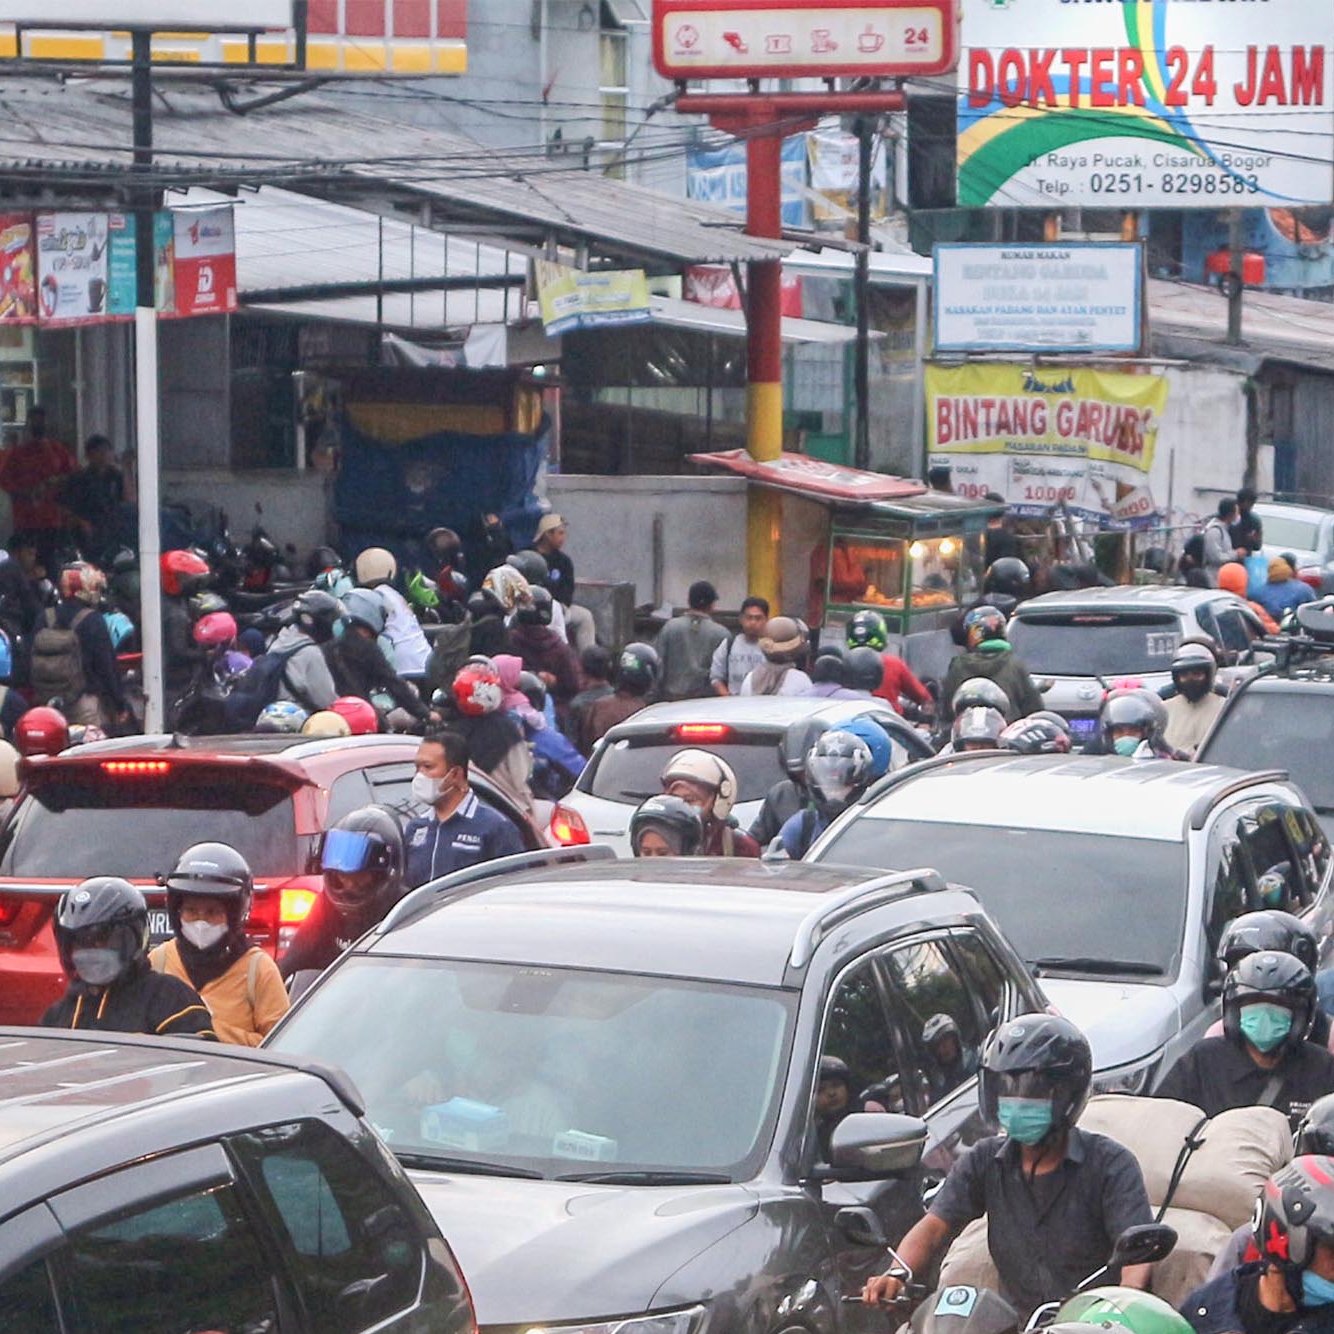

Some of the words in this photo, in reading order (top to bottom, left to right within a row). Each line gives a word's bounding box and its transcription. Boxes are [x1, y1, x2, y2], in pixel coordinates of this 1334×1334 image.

[904, 27, 929, 44] 24
[968, 47, 1145, 108] DOKTER
[1164, 46, 1216, 106] 24
[1234, 45, 1324, 106] JAM
[1047, 153, 1087, 169] Raya
[1153, 152, 1216, 168] Cisarua
[1222, 152, 1272, 170] Bogor
[936, 397, 1047, 445] BINTANG
